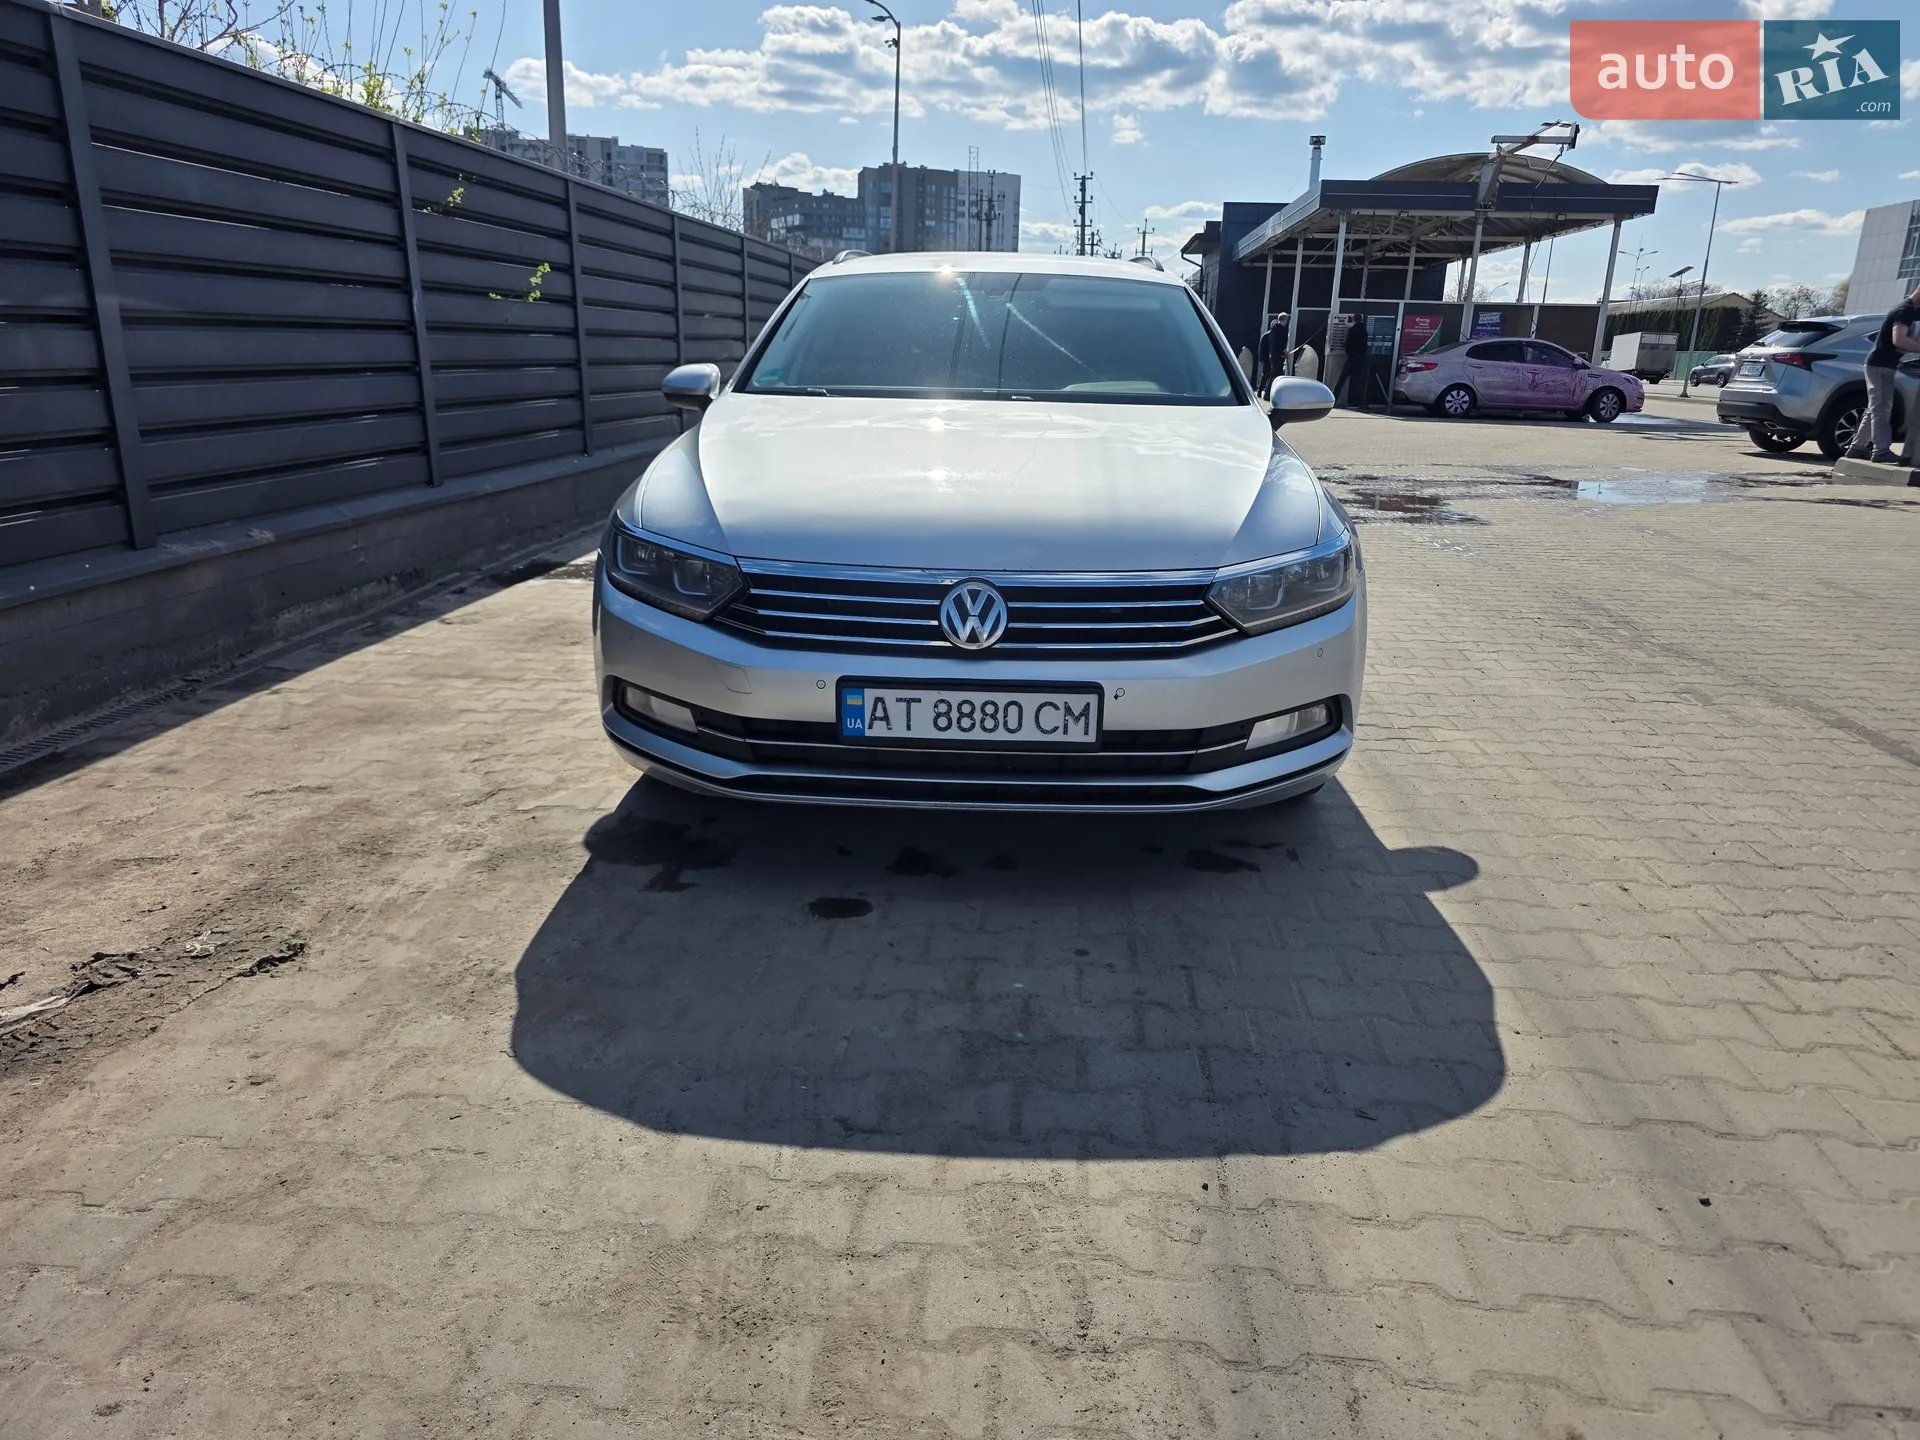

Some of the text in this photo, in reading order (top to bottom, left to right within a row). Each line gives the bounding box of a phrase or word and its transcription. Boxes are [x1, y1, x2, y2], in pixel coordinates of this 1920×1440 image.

[942, 583, 1006, 647] VW
[847, 718, 863, 730] UA
[867, 696, 1091, 736] AT 8880 CM
